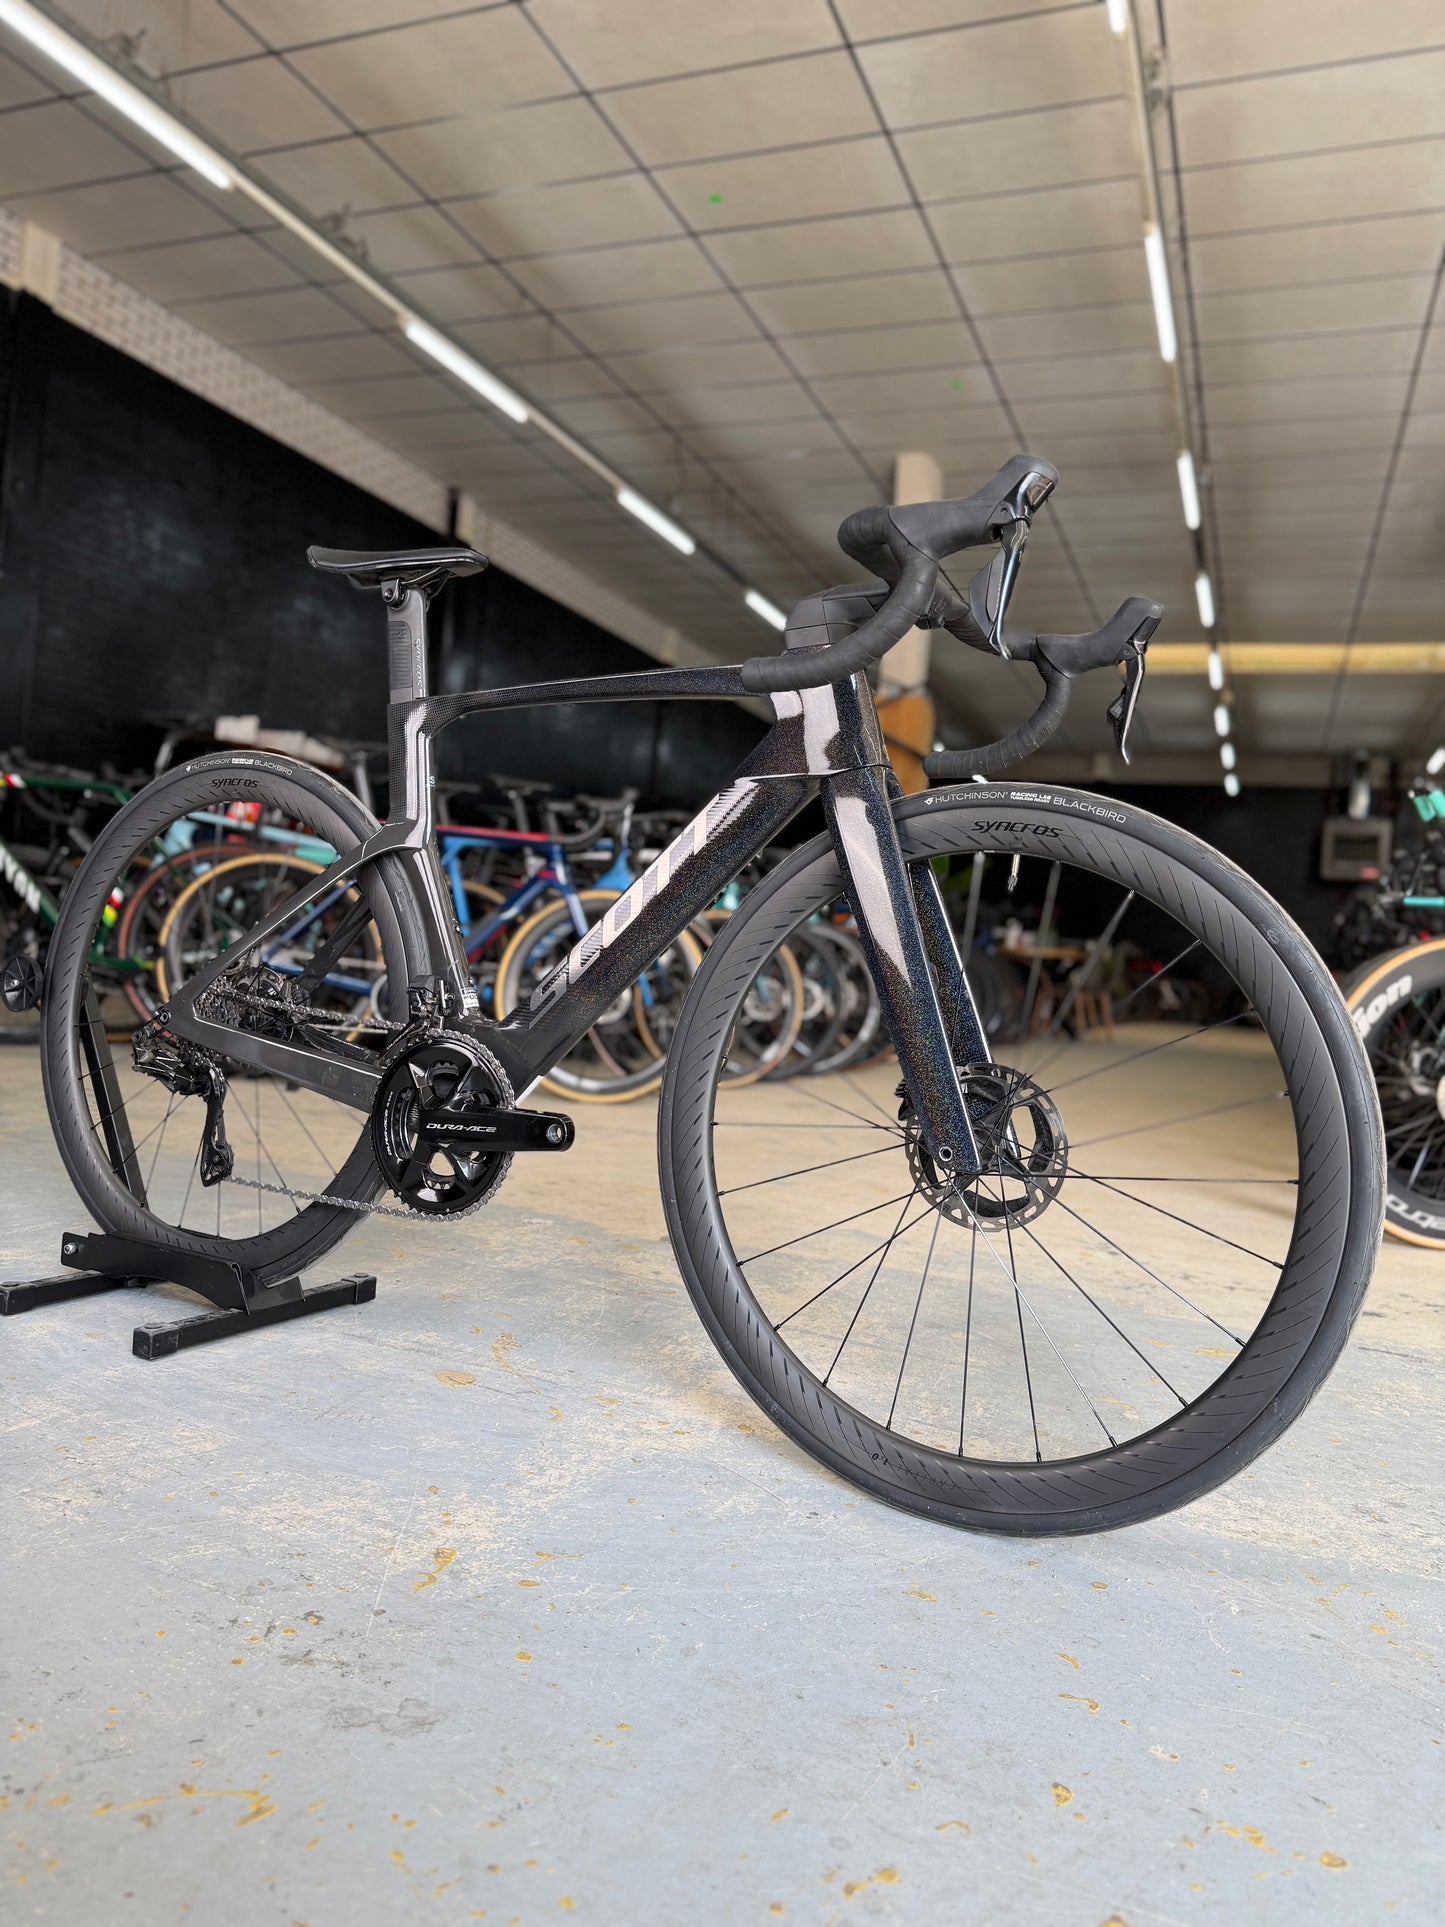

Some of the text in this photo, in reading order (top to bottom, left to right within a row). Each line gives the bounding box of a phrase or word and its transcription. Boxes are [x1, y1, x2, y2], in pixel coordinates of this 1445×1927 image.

[190, 759, 229, 769] HUTCHINSON
[254, 759, 293, 776] BLACKBIRD
[935, 791, 1005, 804] HUTCHINSON
[1053, 796, 1127, 824] BLACKBIRD
[529, 793, 720, 1030] SCOTT
[426, 1123, 497, 1133] DURA-ACE
